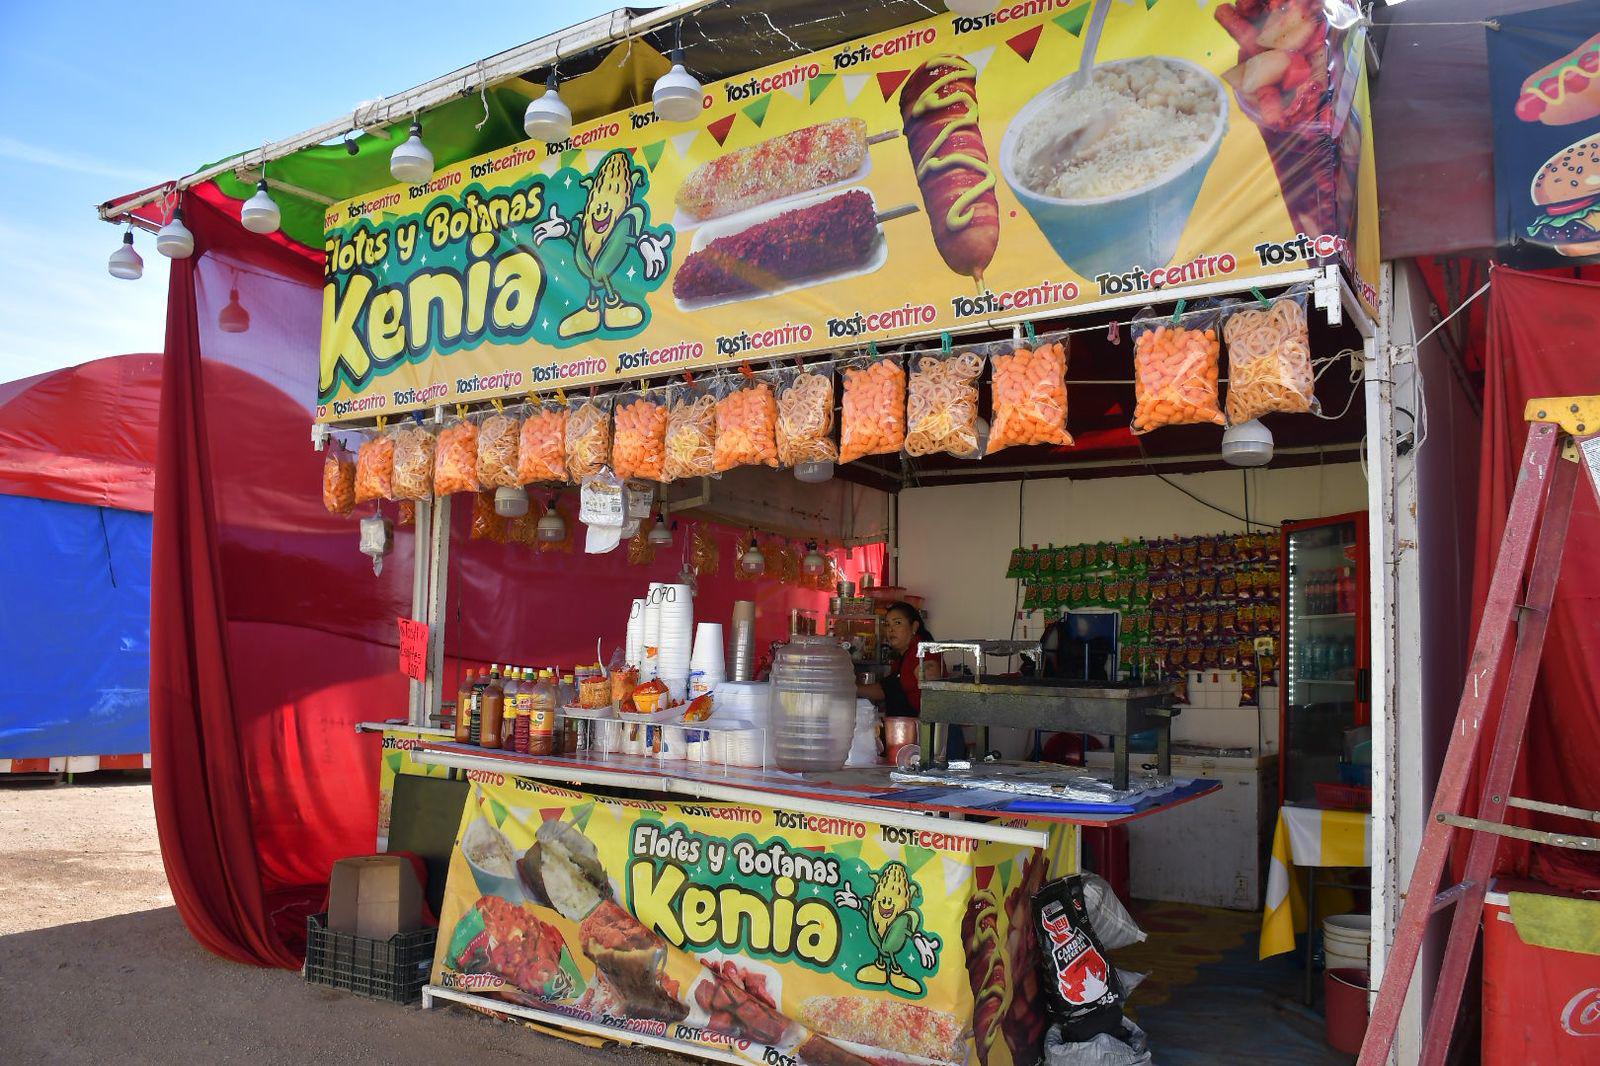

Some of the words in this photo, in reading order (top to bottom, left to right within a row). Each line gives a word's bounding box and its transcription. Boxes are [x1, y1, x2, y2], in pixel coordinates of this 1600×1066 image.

[396, 224, 417, 260] y
[427, 186, 543, 247] Botanas
[319, 233, 541, 393] Kenia
[633, 826, 700, 863] Elotes
[708, 842, 725, 873] y
[733, 842, 840, 886] Botanas
[632, 860, 838, 963] Kenia
